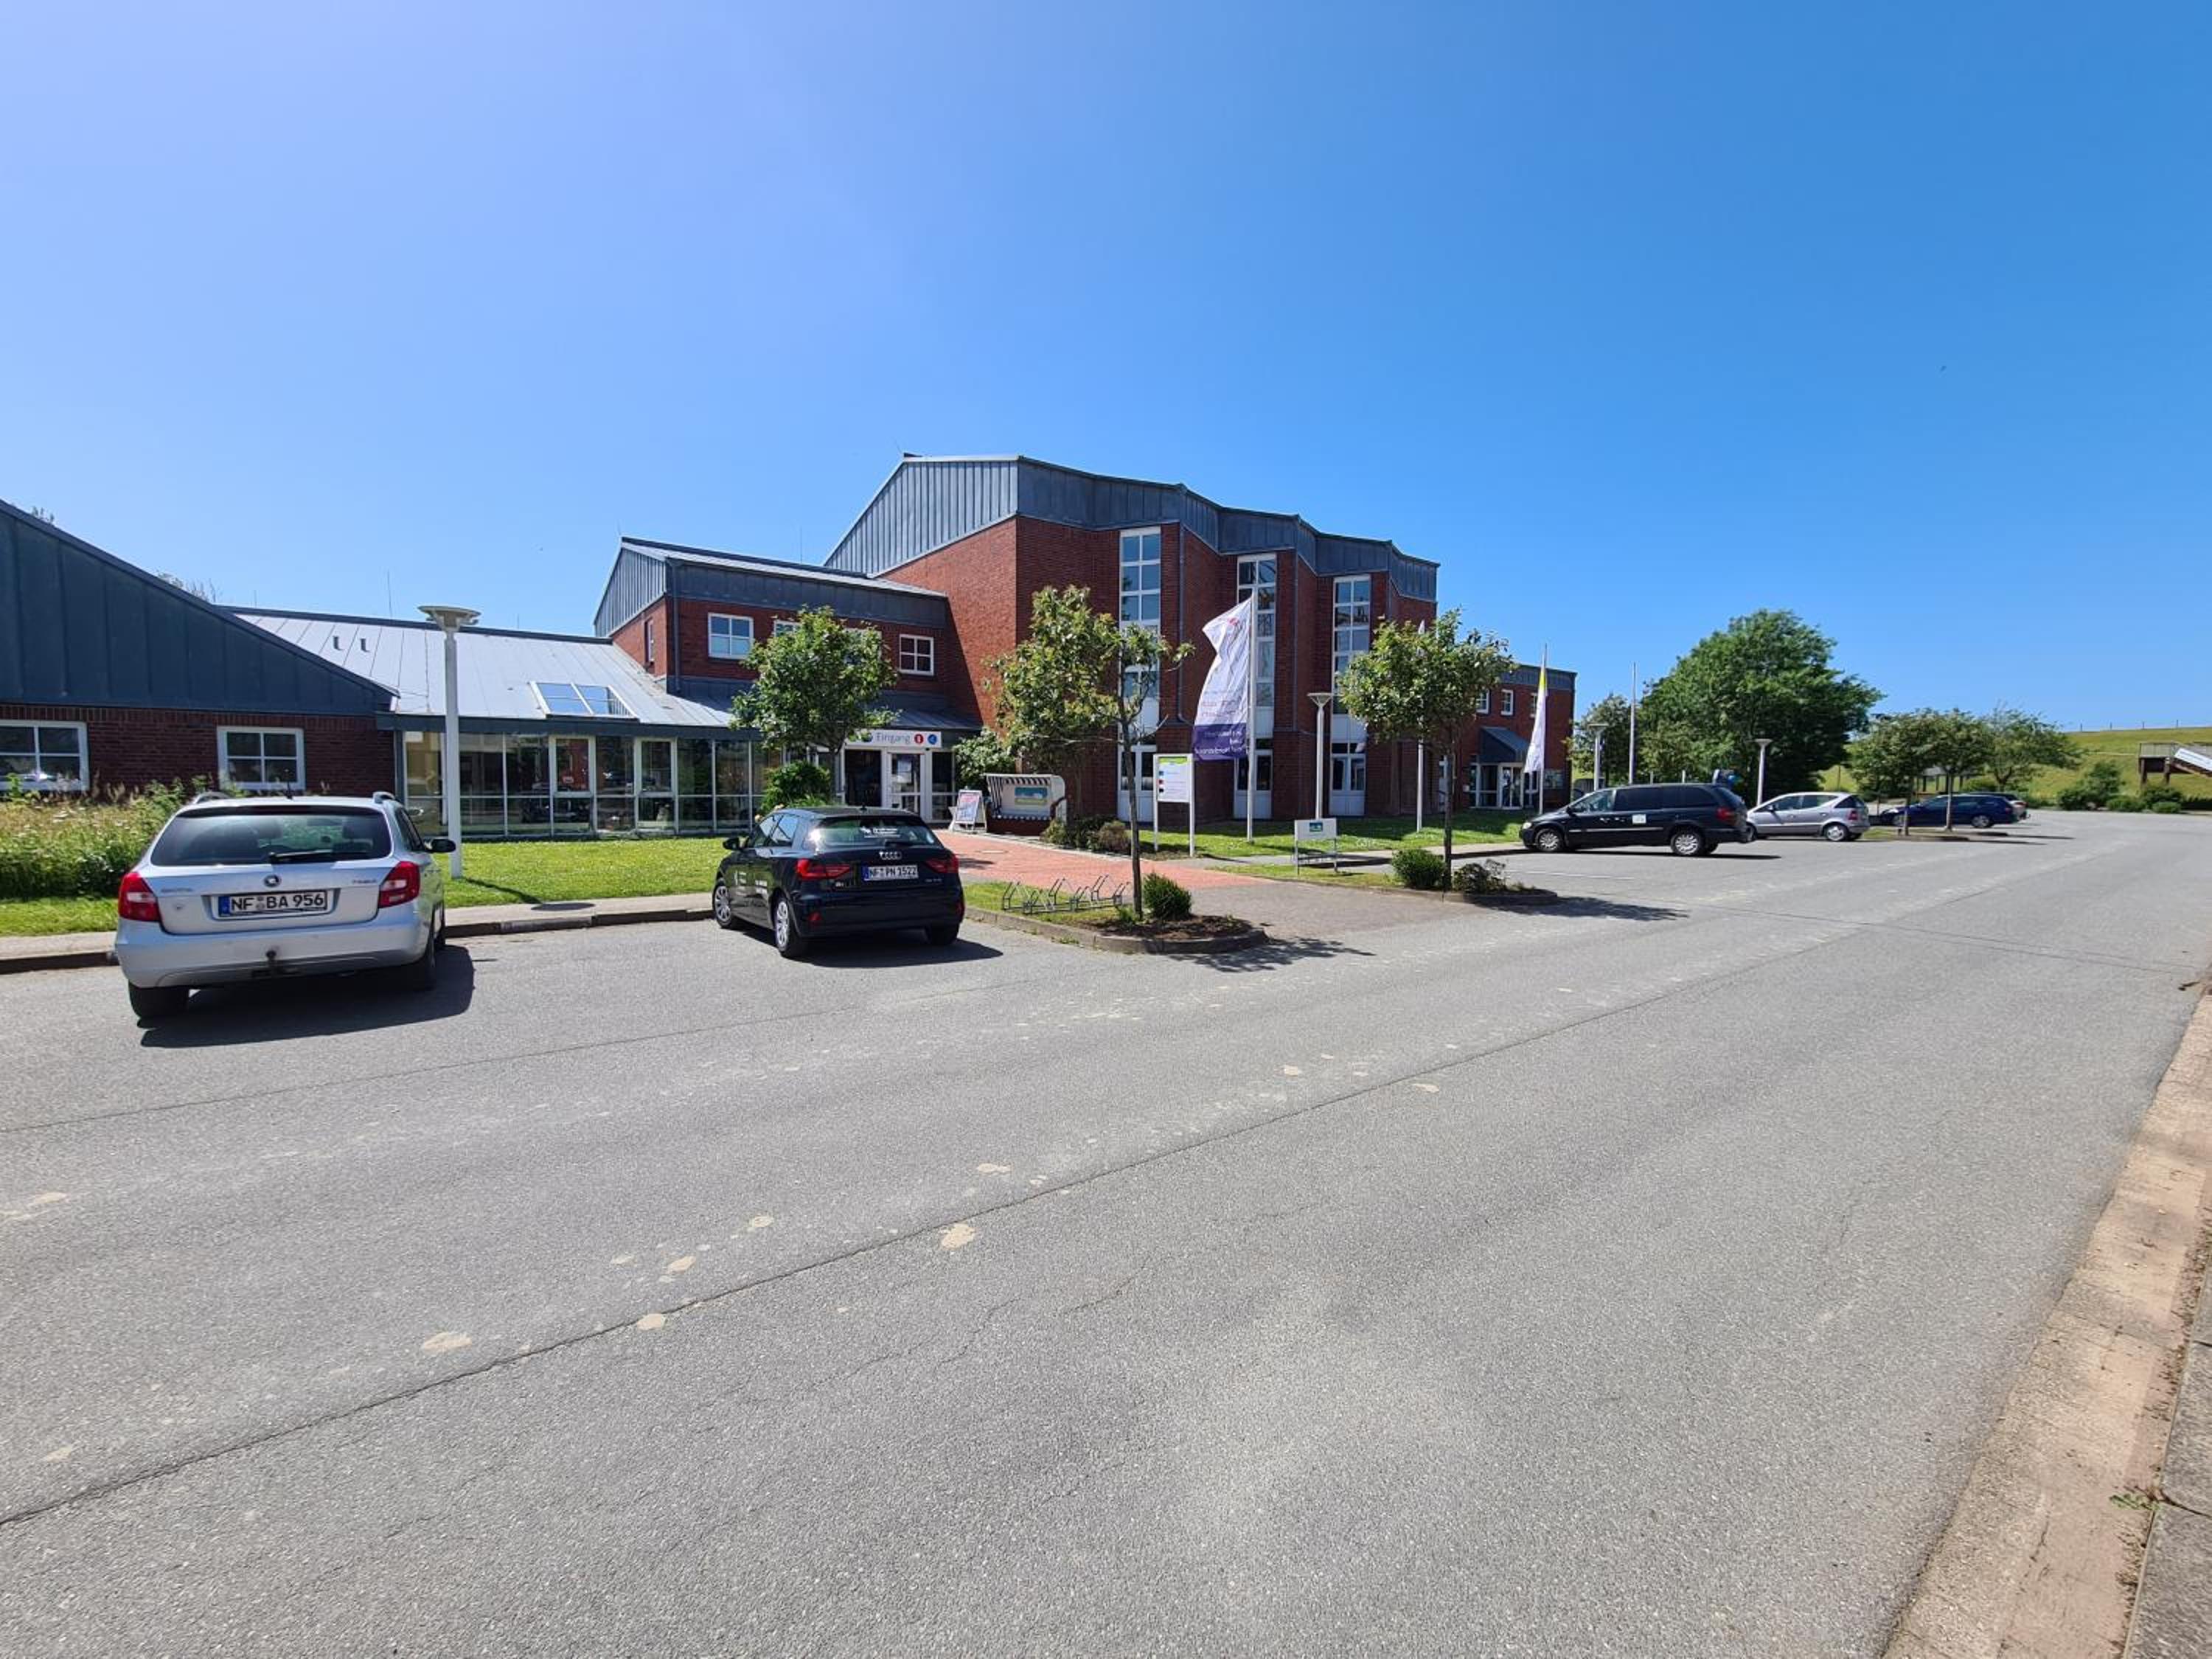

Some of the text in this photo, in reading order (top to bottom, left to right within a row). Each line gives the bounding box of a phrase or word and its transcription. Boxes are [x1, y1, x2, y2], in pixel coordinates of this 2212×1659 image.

[875, 732, 911, 744] Eingang
[232, 894, 324, 911] NF BA 956
